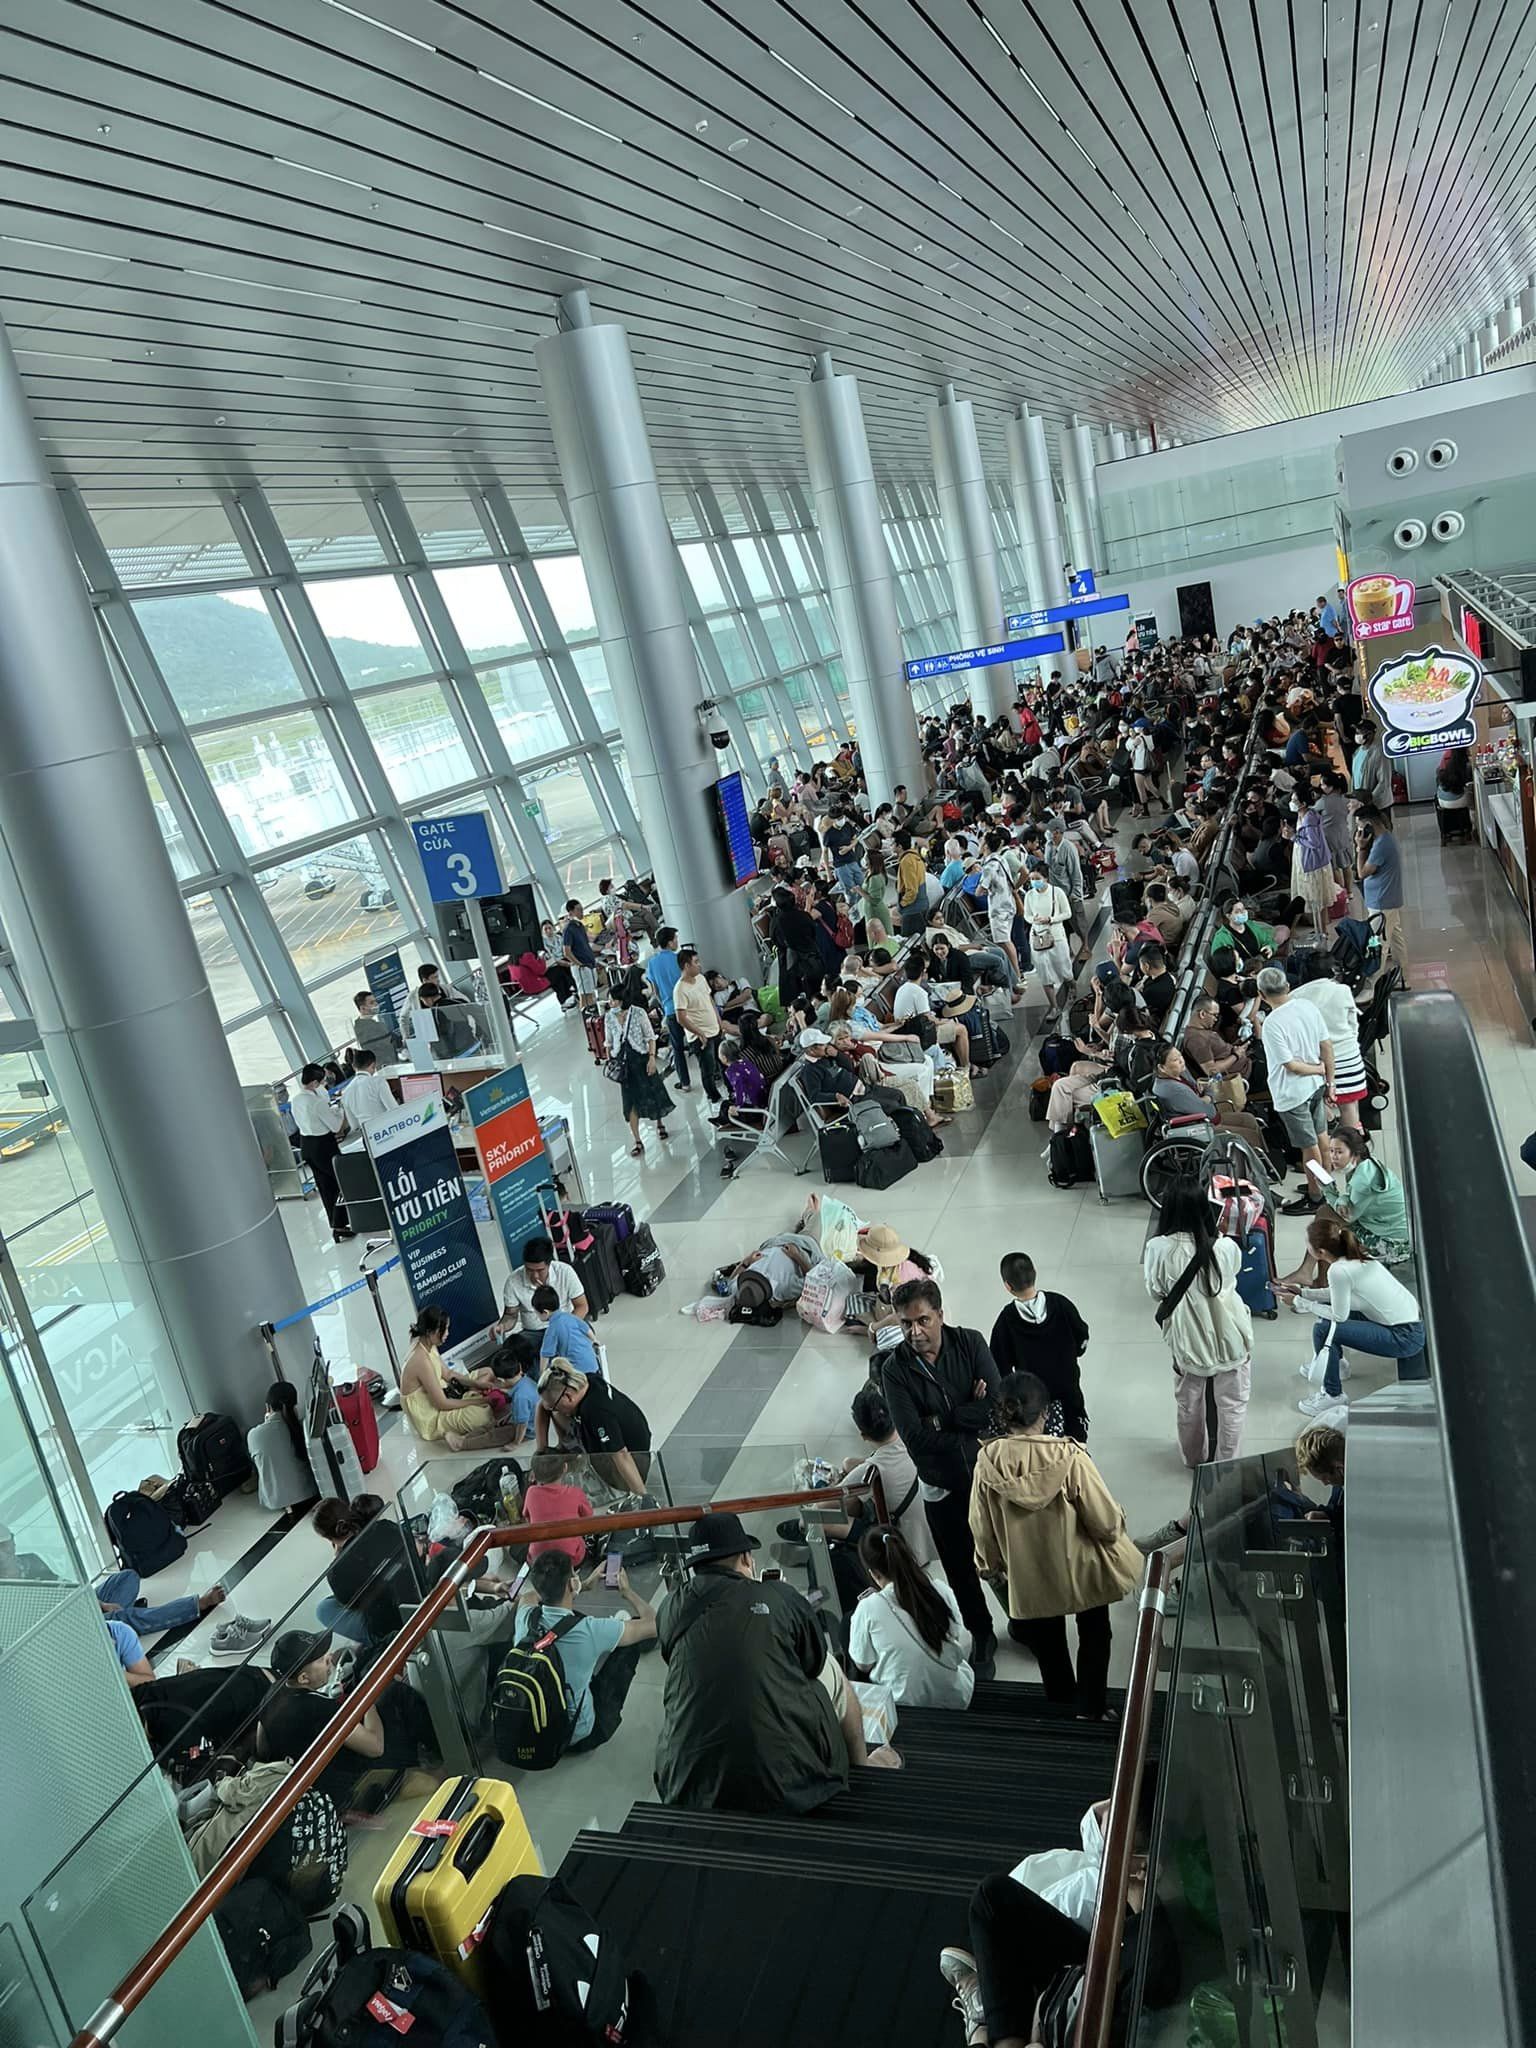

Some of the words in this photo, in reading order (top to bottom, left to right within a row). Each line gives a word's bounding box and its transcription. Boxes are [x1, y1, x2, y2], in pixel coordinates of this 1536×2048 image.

[1079, 581, 1087, 593] 4
[419, 822, 456, 836] GATE
[423, 836, 452, 851] CỬA
[446, 853, 477, 896] 3
[373, 1114, 421, 1141] BAMBOO
[486, 1141, 507, 1161] SKY
[488, 1135, 537, 1173] PRIORITY
[387, 1166, 417, 1202] LỐI
[394, 1196, 422, 1226] ƯU
[422, 1177, 461, 1211] TIÊN
[401, 1209, 449, 1241] PRIORITY
[407, 1248, 421, 1260] VIP
[410, 1245, 447, 1271] BUSINESS
[413, 1268, 426, 1281] CIP
[416, 1268, 448, 1291] BAMBOO
[447, 1257, 467, 1273] CLUB
